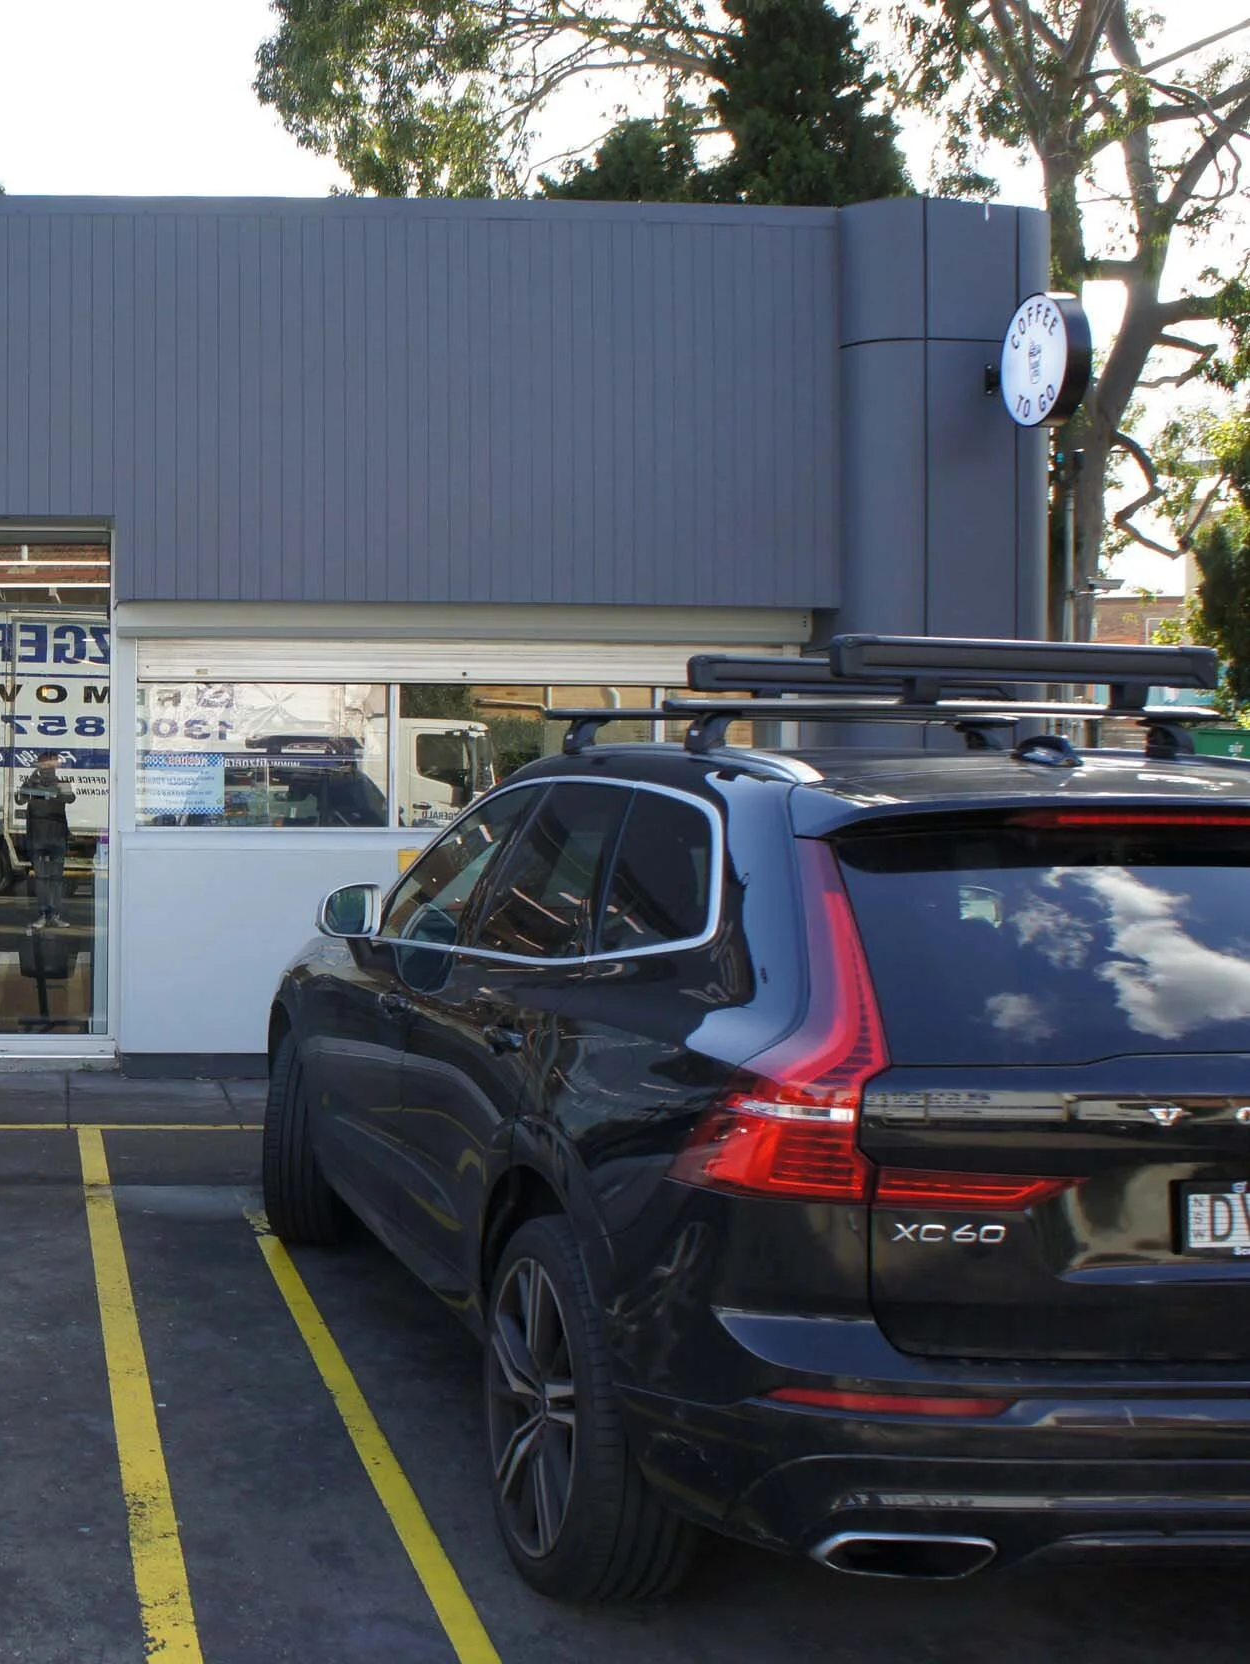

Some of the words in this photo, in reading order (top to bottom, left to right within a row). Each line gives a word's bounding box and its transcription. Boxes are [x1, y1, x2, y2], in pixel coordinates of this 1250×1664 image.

[1010, 304, 1058, 349] COFFEE
[1015, 394, 1031, 418] TO
[1039, 384, 1055, 412] GO
